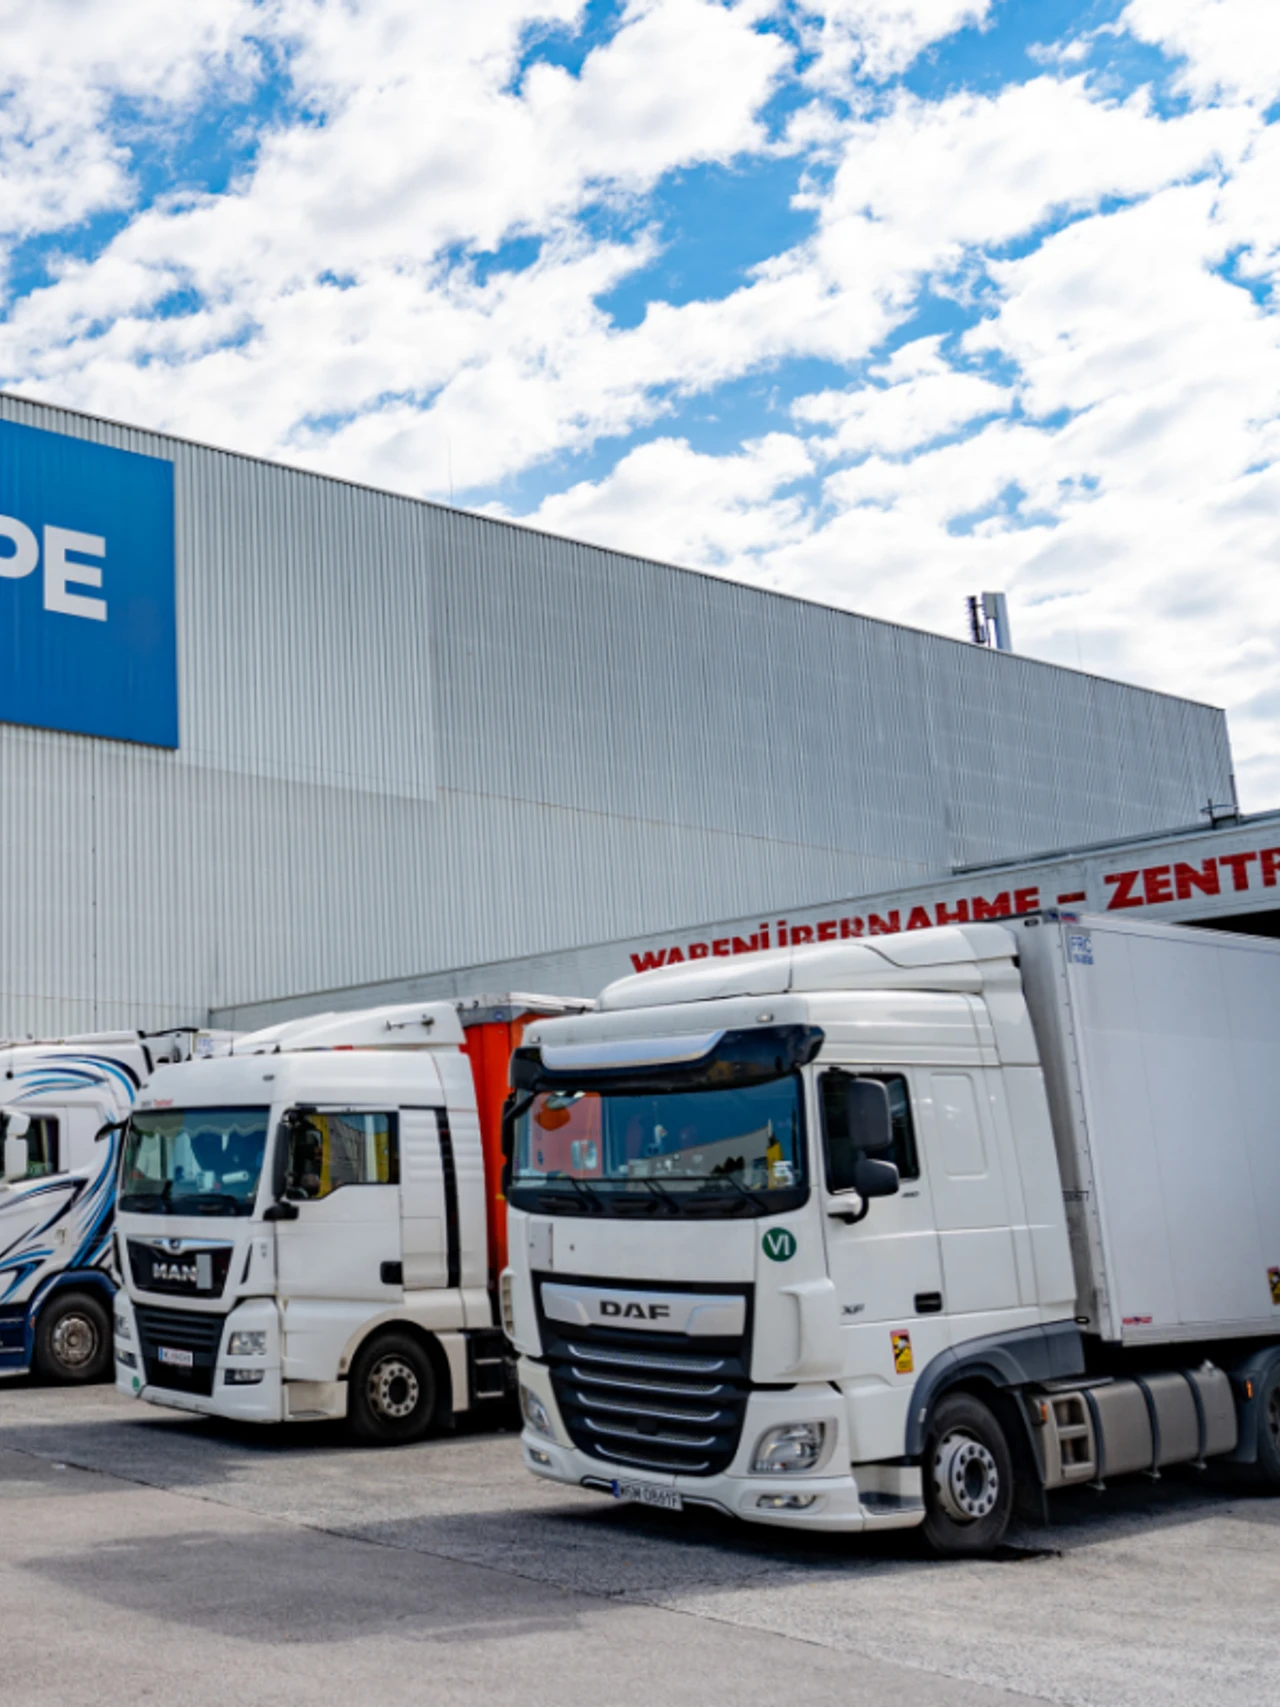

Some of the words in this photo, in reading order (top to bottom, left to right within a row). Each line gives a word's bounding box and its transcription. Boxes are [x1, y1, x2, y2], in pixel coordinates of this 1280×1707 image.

[766, 1234, 790, 1257] VI
[152, 1262, 199, 1283] MAN
[599, 1299, 671, 1321] DAF
